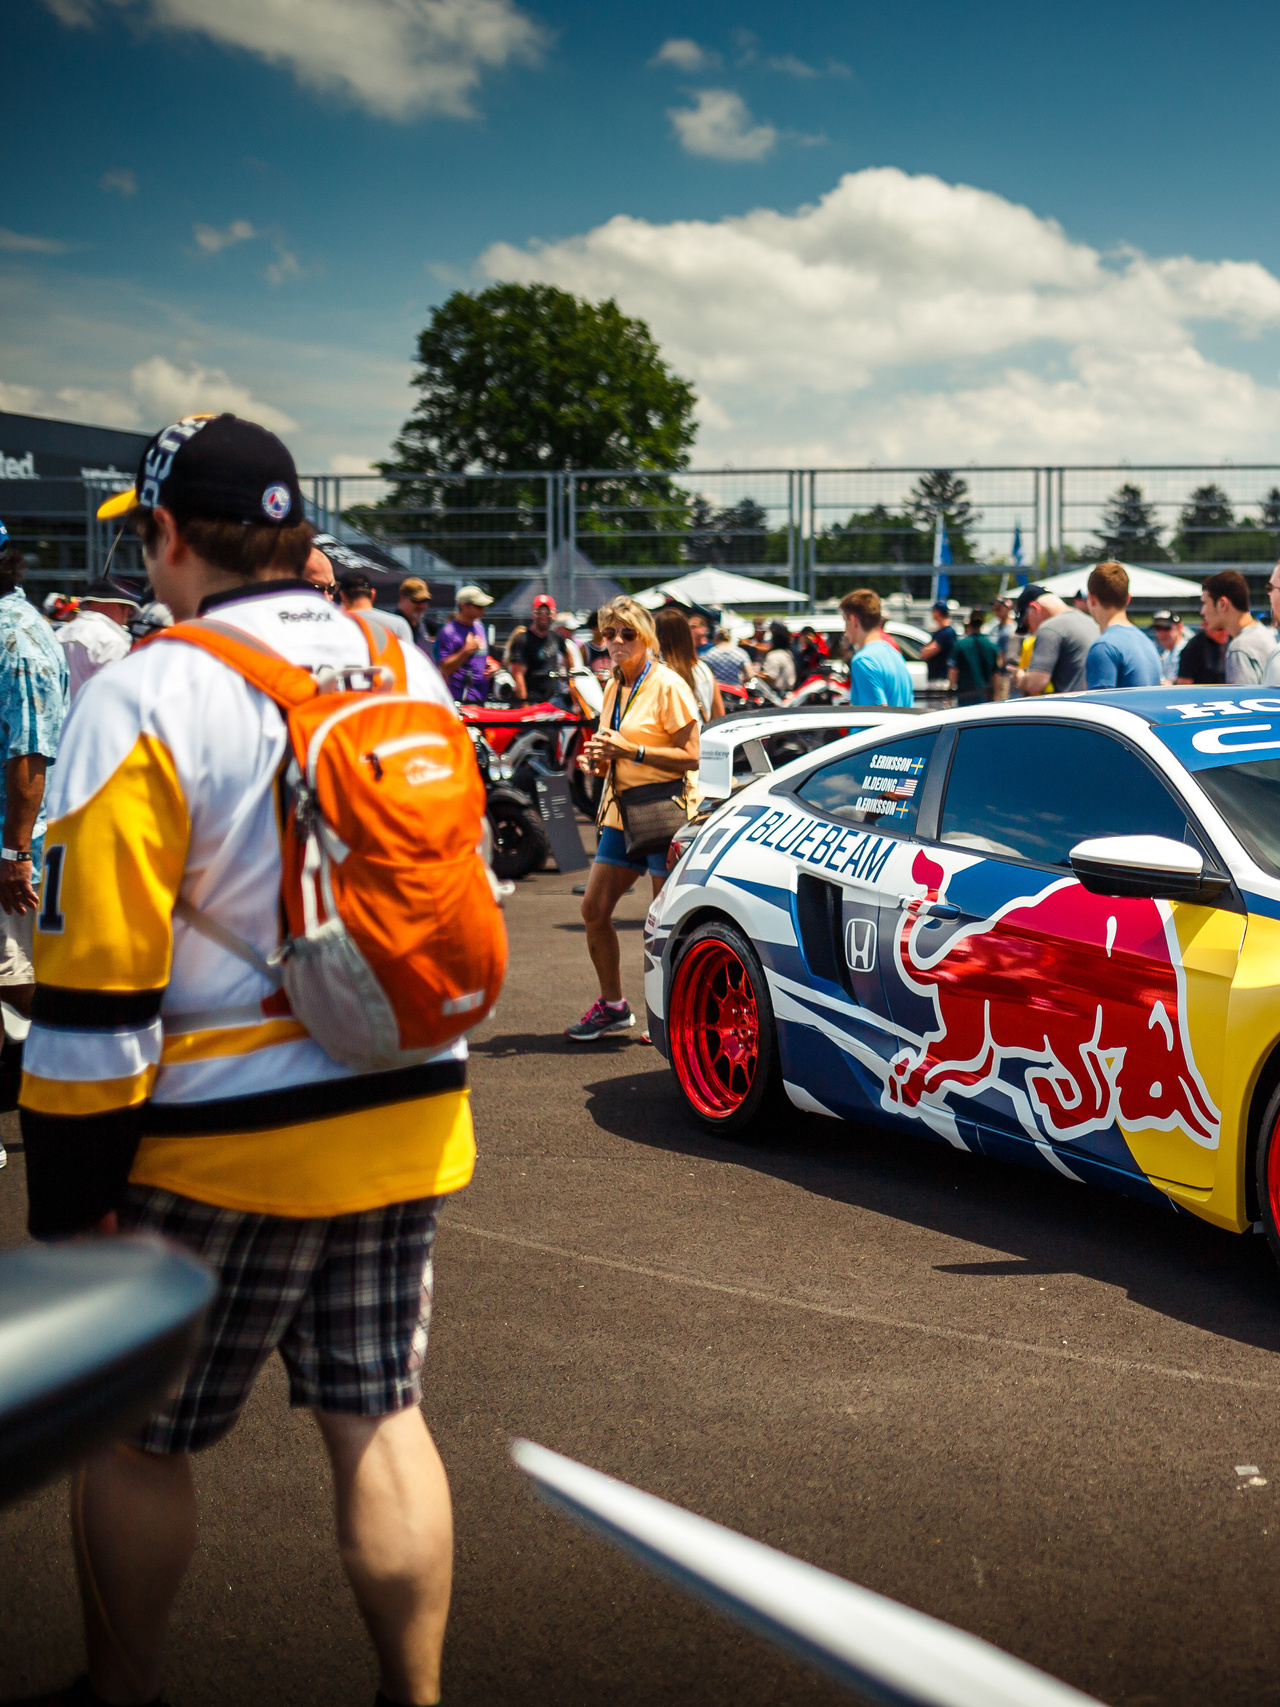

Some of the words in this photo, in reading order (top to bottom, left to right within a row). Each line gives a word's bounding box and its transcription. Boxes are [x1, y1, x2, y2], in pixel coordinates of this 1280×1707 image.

[278, 608, 333, 624] Reebok
[870, 754, 912, 772] S.ERIKSSON
[862, 775, 898, 793] M.DEJONG
[855, 797, 897, 816] O.ERIKSSON
[746, 811, 898, 883] BLUEBEAM
[37, 843, 66, 934] 1
